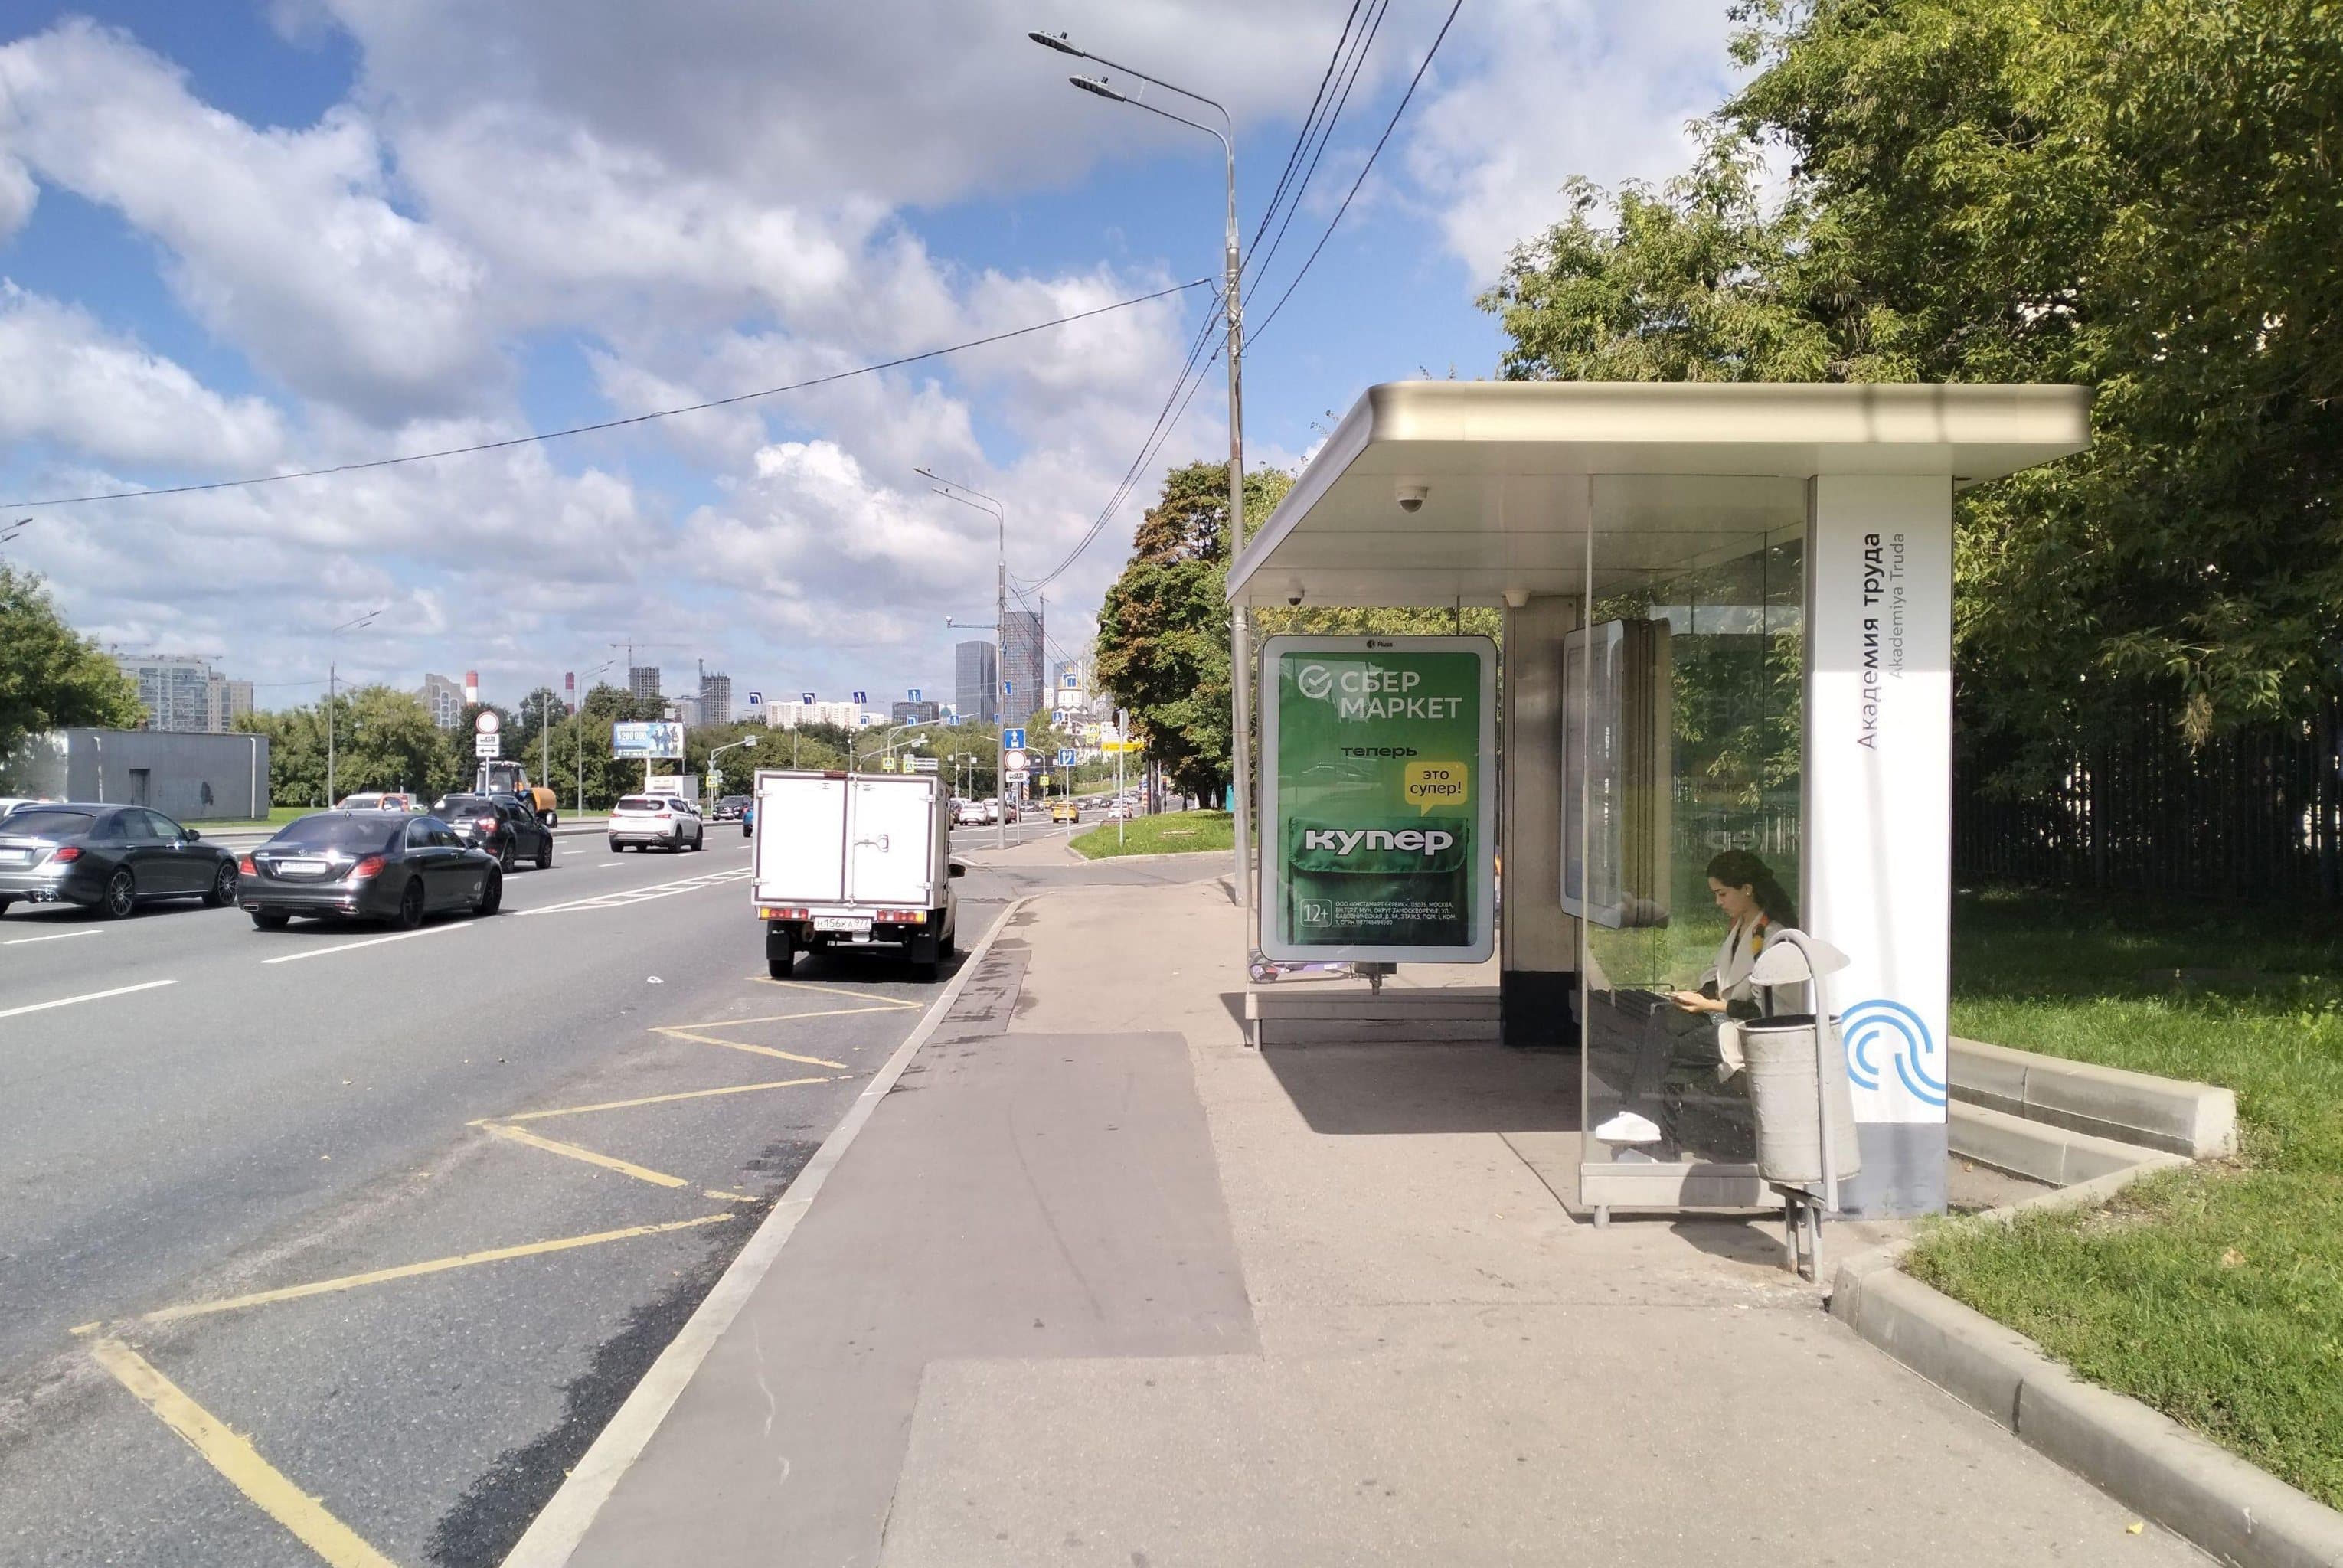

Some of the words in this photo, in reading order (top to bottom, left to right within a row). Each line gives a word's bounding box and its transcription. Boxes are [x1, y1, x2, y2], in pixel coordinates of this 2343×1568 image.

[1889, 533, 1904, 582] Truda
[1864, 533, 1884, 606] труда
[1888, 586, 1907, 679] Akademiya
[1341, 671, 1420, 693] СБЕР
[1857, 617, 1881, 750] Академия
[1341, 697, 1462, 718] МАРКЕТ
[1341, 746, 1417, 759] теперь
[1423, 770, 1449, 780] это
[1410, 782, 1461, 796] супер!
[1305, 828, 1453, 856] купер
[1303, 903, 1329, 922] 12+
